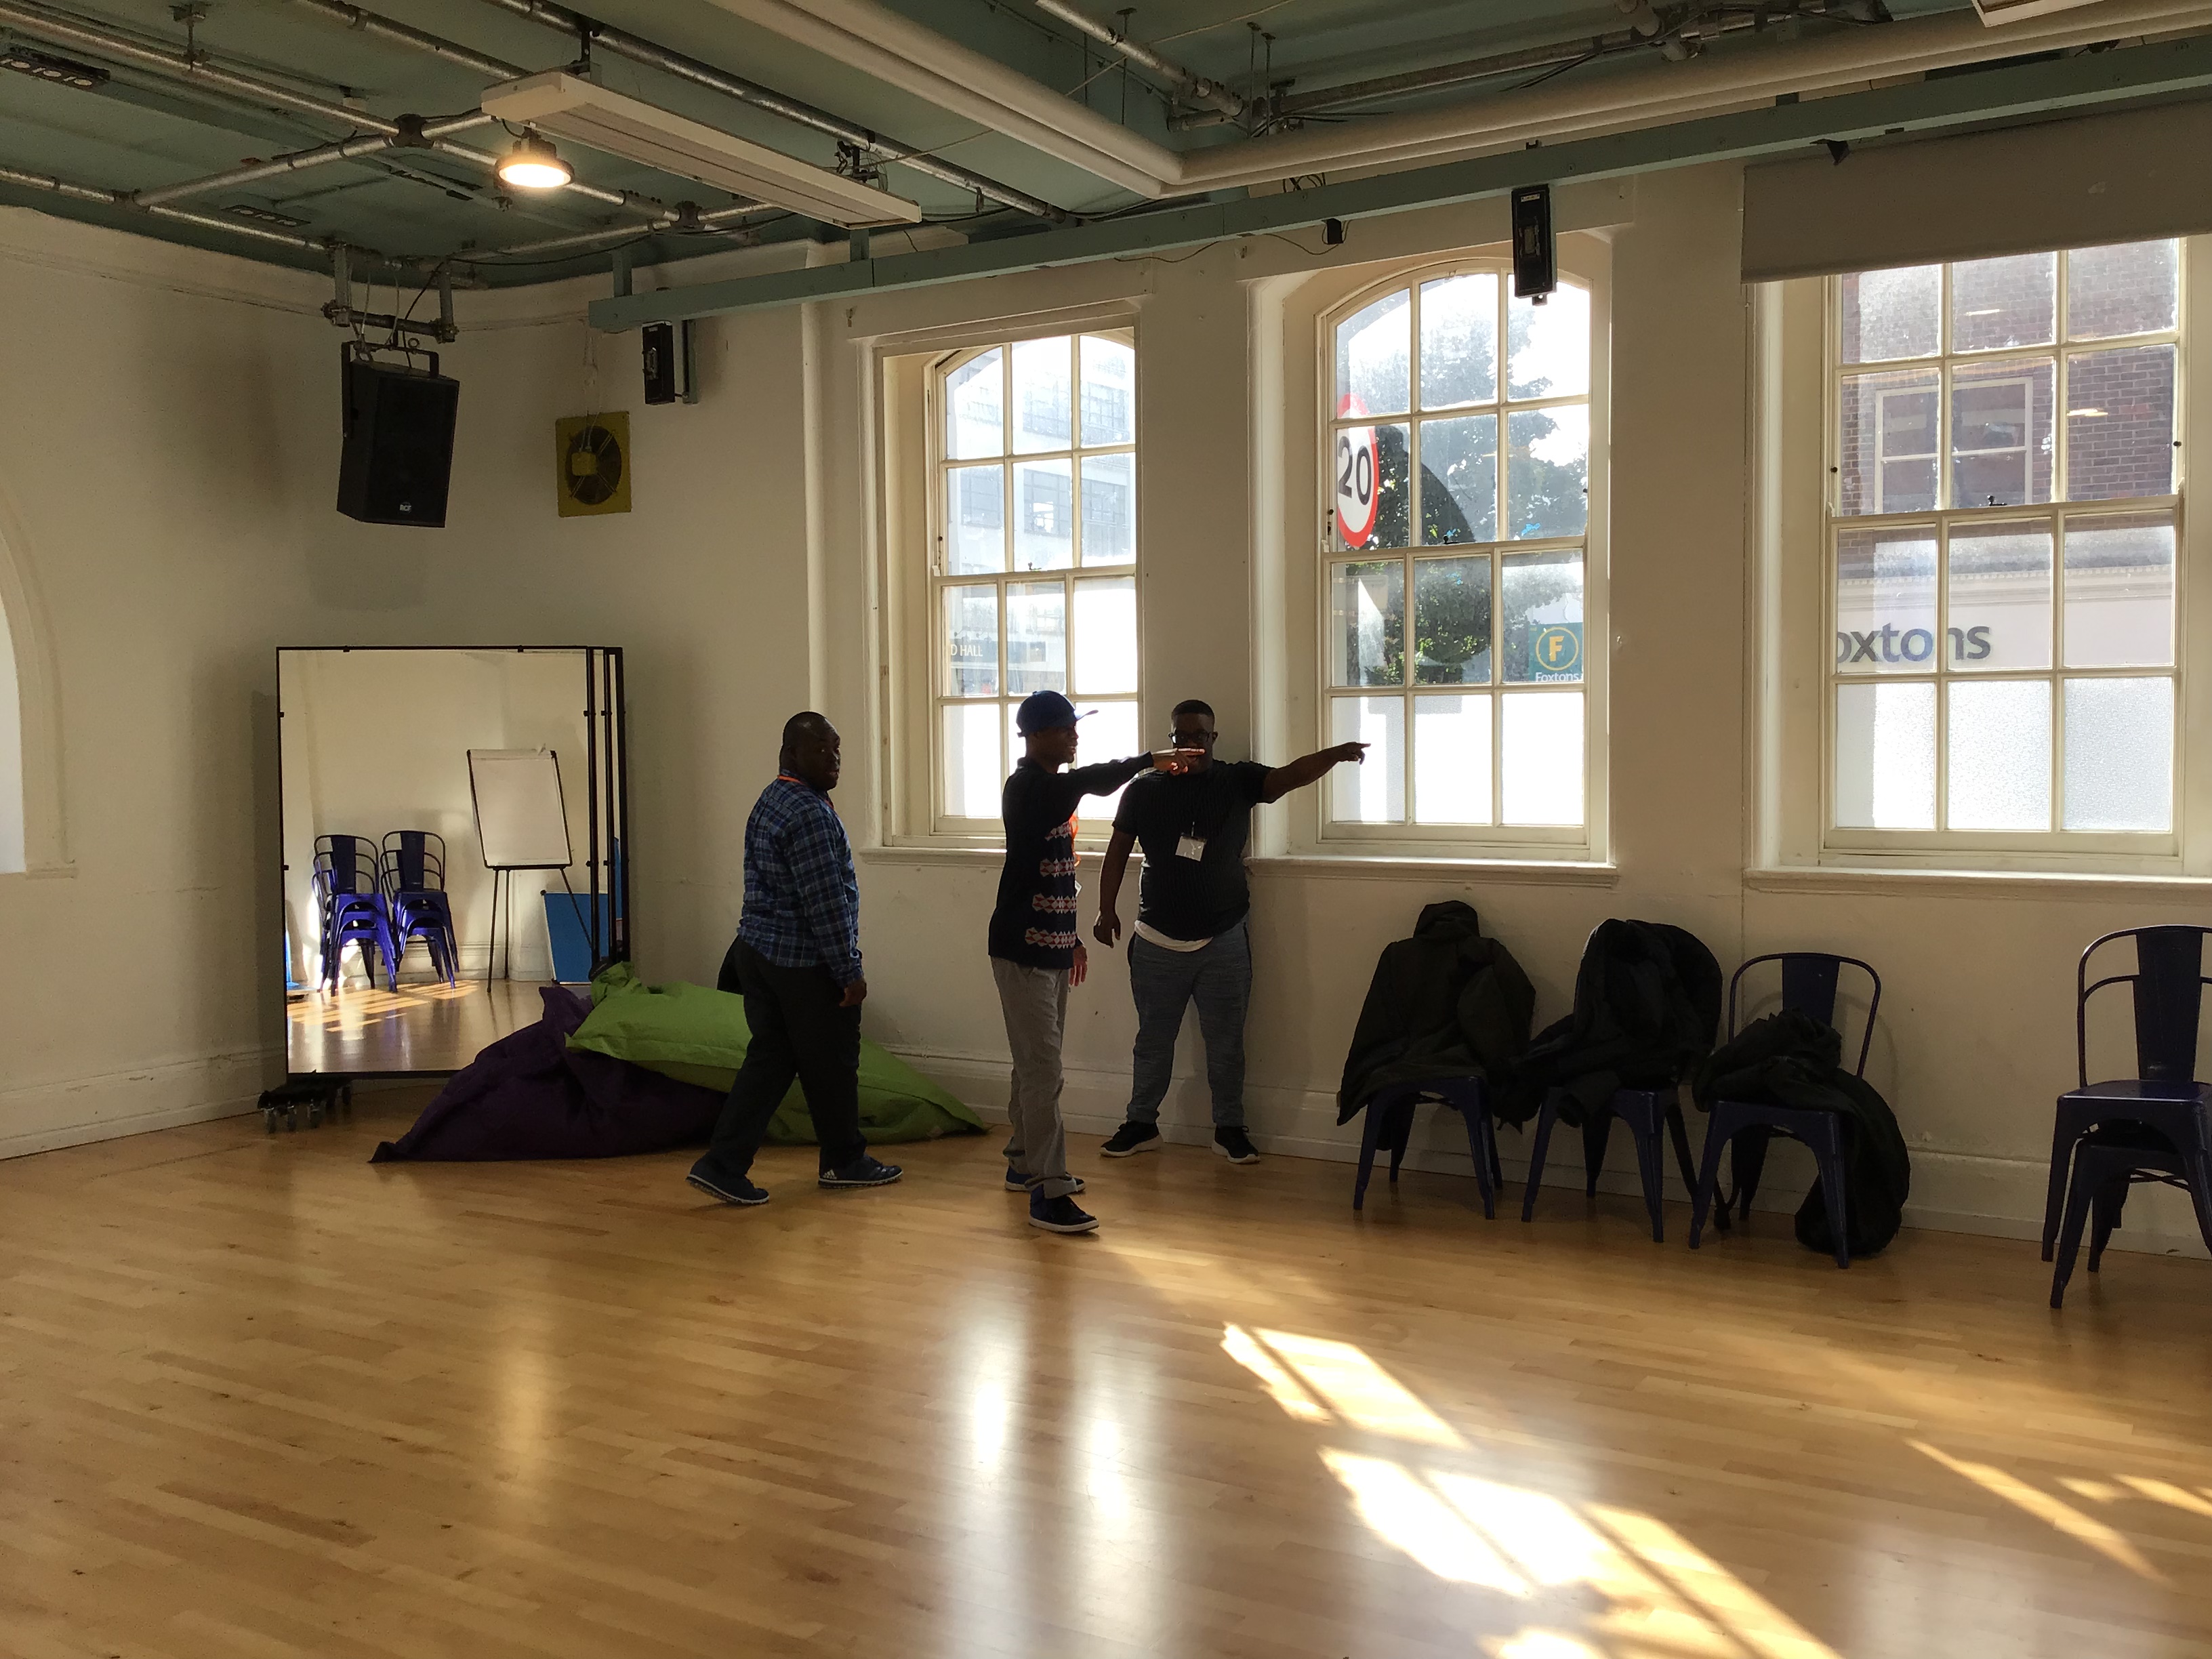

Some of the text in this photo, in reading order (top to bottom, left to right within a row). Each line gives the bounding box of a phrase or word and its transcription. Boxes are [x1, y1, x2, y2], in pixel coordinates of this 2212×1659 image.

[1338, 436, 1372, 506] 20
[960, 644, 983, 657] HALL
[1549, 636, 1564, 661] F
[1535, 672, 1580, 682] Foxtons
